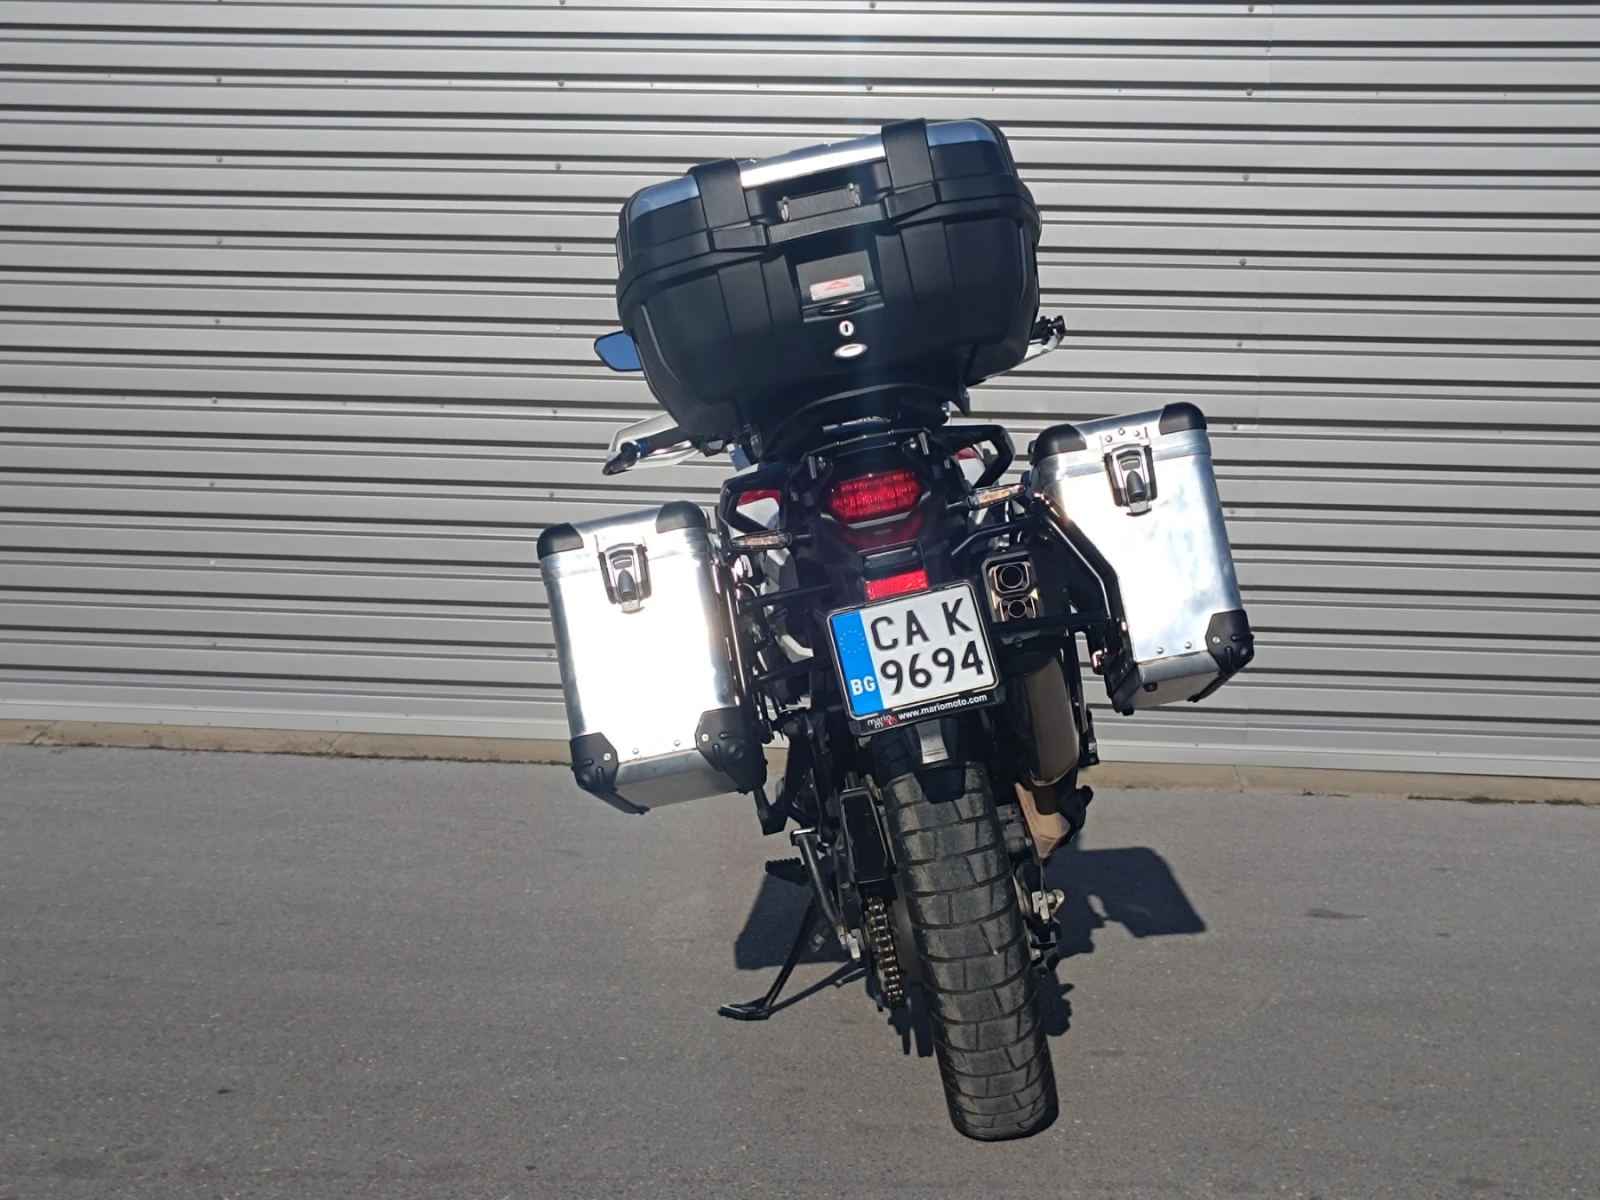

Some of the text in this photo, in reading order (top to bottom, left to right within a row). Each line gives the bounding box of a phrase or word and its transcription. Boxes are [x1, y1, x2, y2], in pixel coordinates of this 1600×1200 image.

[870, 597, 973, 651] CA K
[880, 640, 984, 696] 9694
[850, 675, 876, 696] BG
[867, 713, 892, 726] mario
[898, 694, 988, 720] www.mariomoto.com
